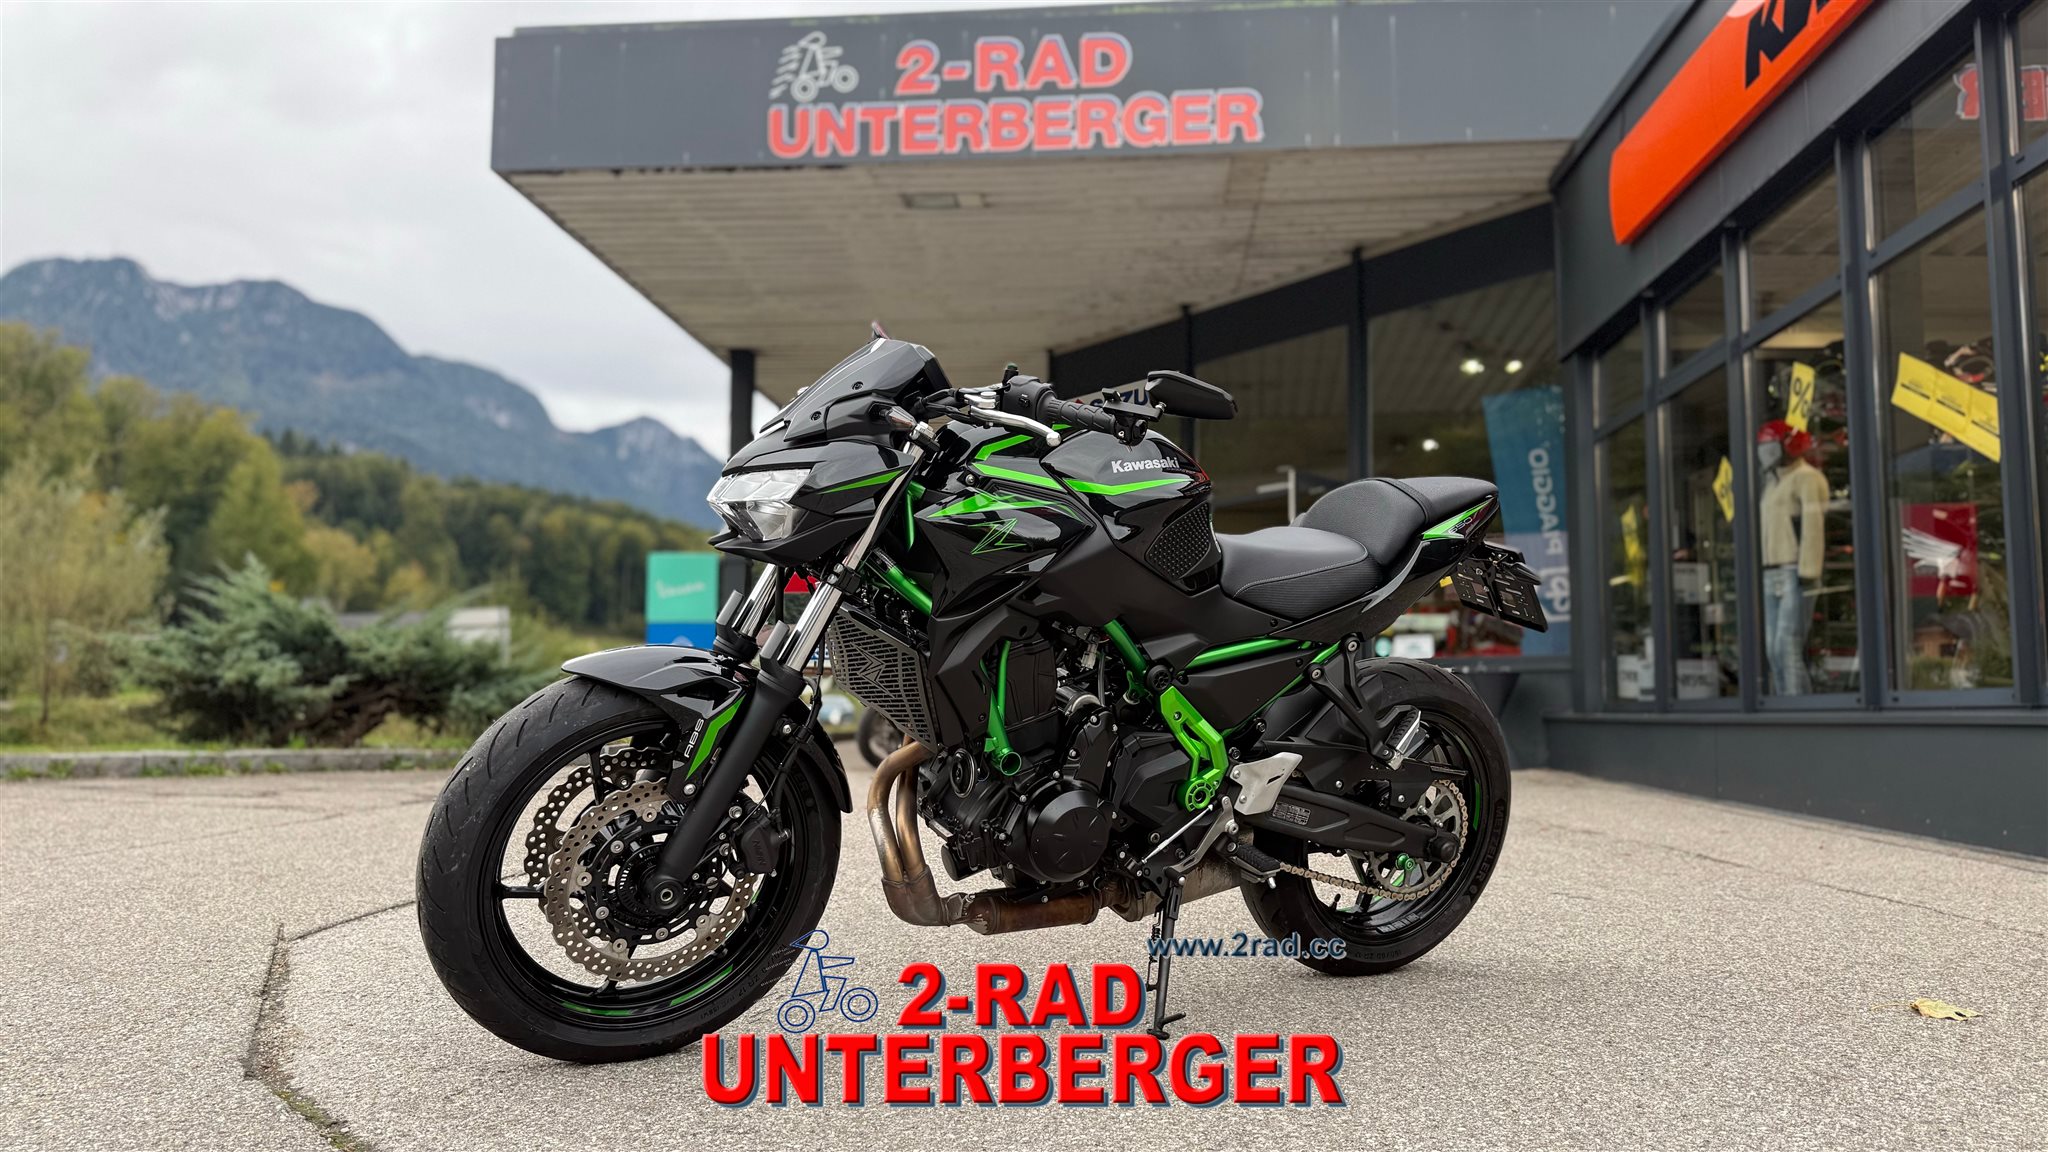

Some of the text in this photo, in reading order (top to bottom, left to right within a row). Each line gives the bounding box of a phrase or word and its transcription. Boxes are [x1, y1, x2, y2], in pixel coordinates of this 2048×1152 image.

[895, 32, 1132, 96] 2-RAD
[767, 90, 1263, 158] UNTERBERGER
[1111, 456, 1180, 474] Kawasaki
[683, 718, 705, 758] ABS
[1475, 804, 1505, 882] METZELER
